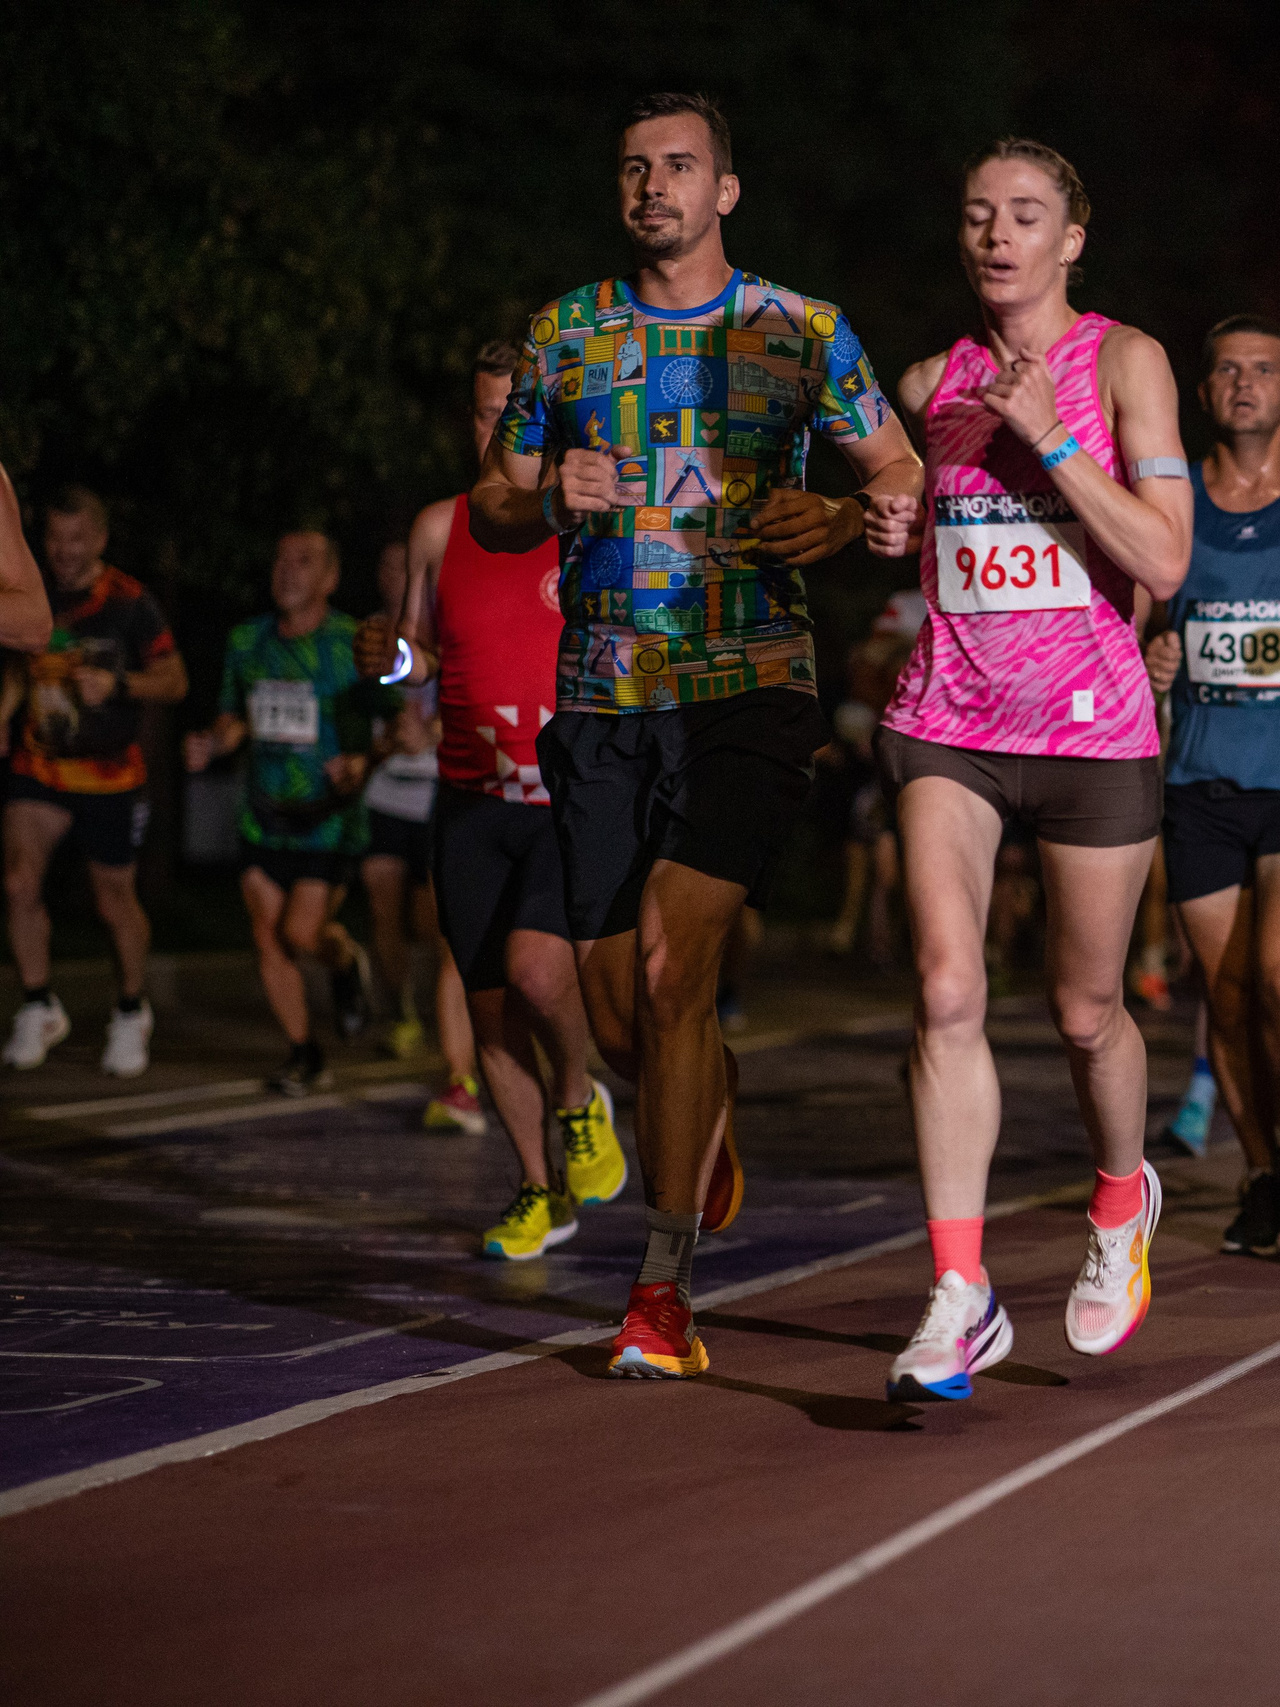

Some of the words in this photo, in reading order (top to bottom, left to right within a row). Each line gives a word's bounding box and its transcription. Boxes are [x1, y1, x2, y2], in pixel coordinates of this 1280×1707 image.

[588, 367, 608, 381] RUN
[956, 544, 1060, 590] 9631
[1200, 632, 1280, 663] 4308
